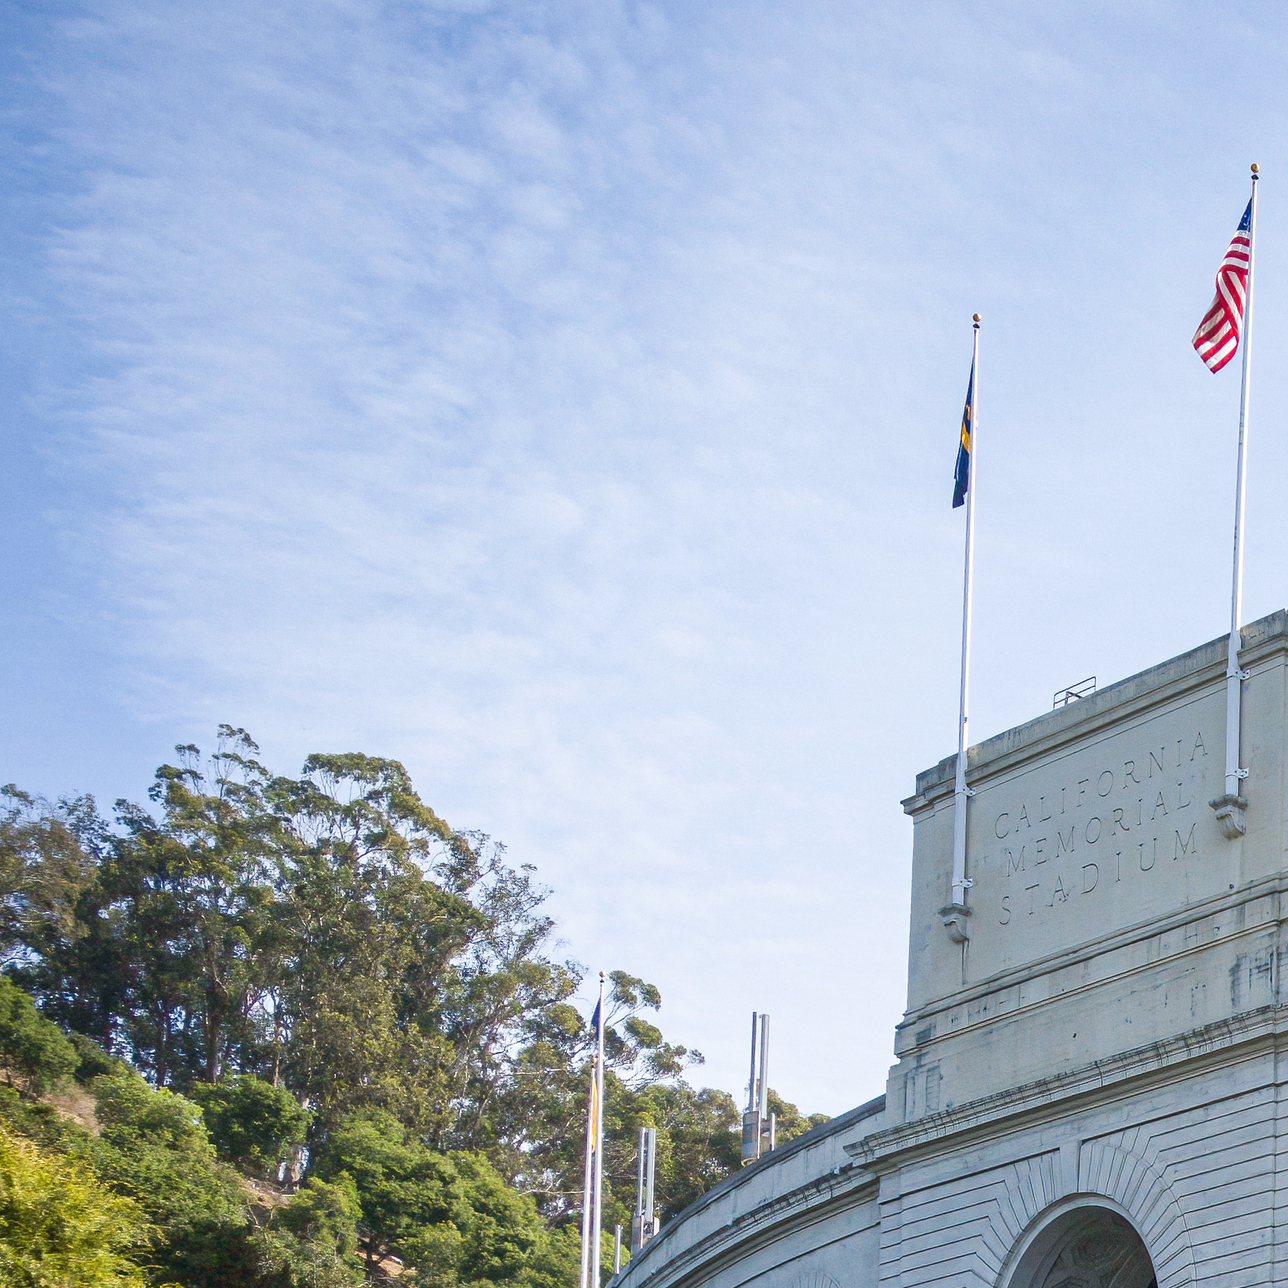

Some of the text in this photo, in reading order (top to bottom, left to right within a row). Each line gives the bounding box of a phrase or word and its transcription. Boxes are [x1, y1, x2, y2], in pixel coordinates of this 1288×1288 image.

[994, 732, 1208, 839] CALIFORNIA
[1005, 782, 1191, 878] MEMORIAL
[998, 822, 1197, 926] STADIUM
